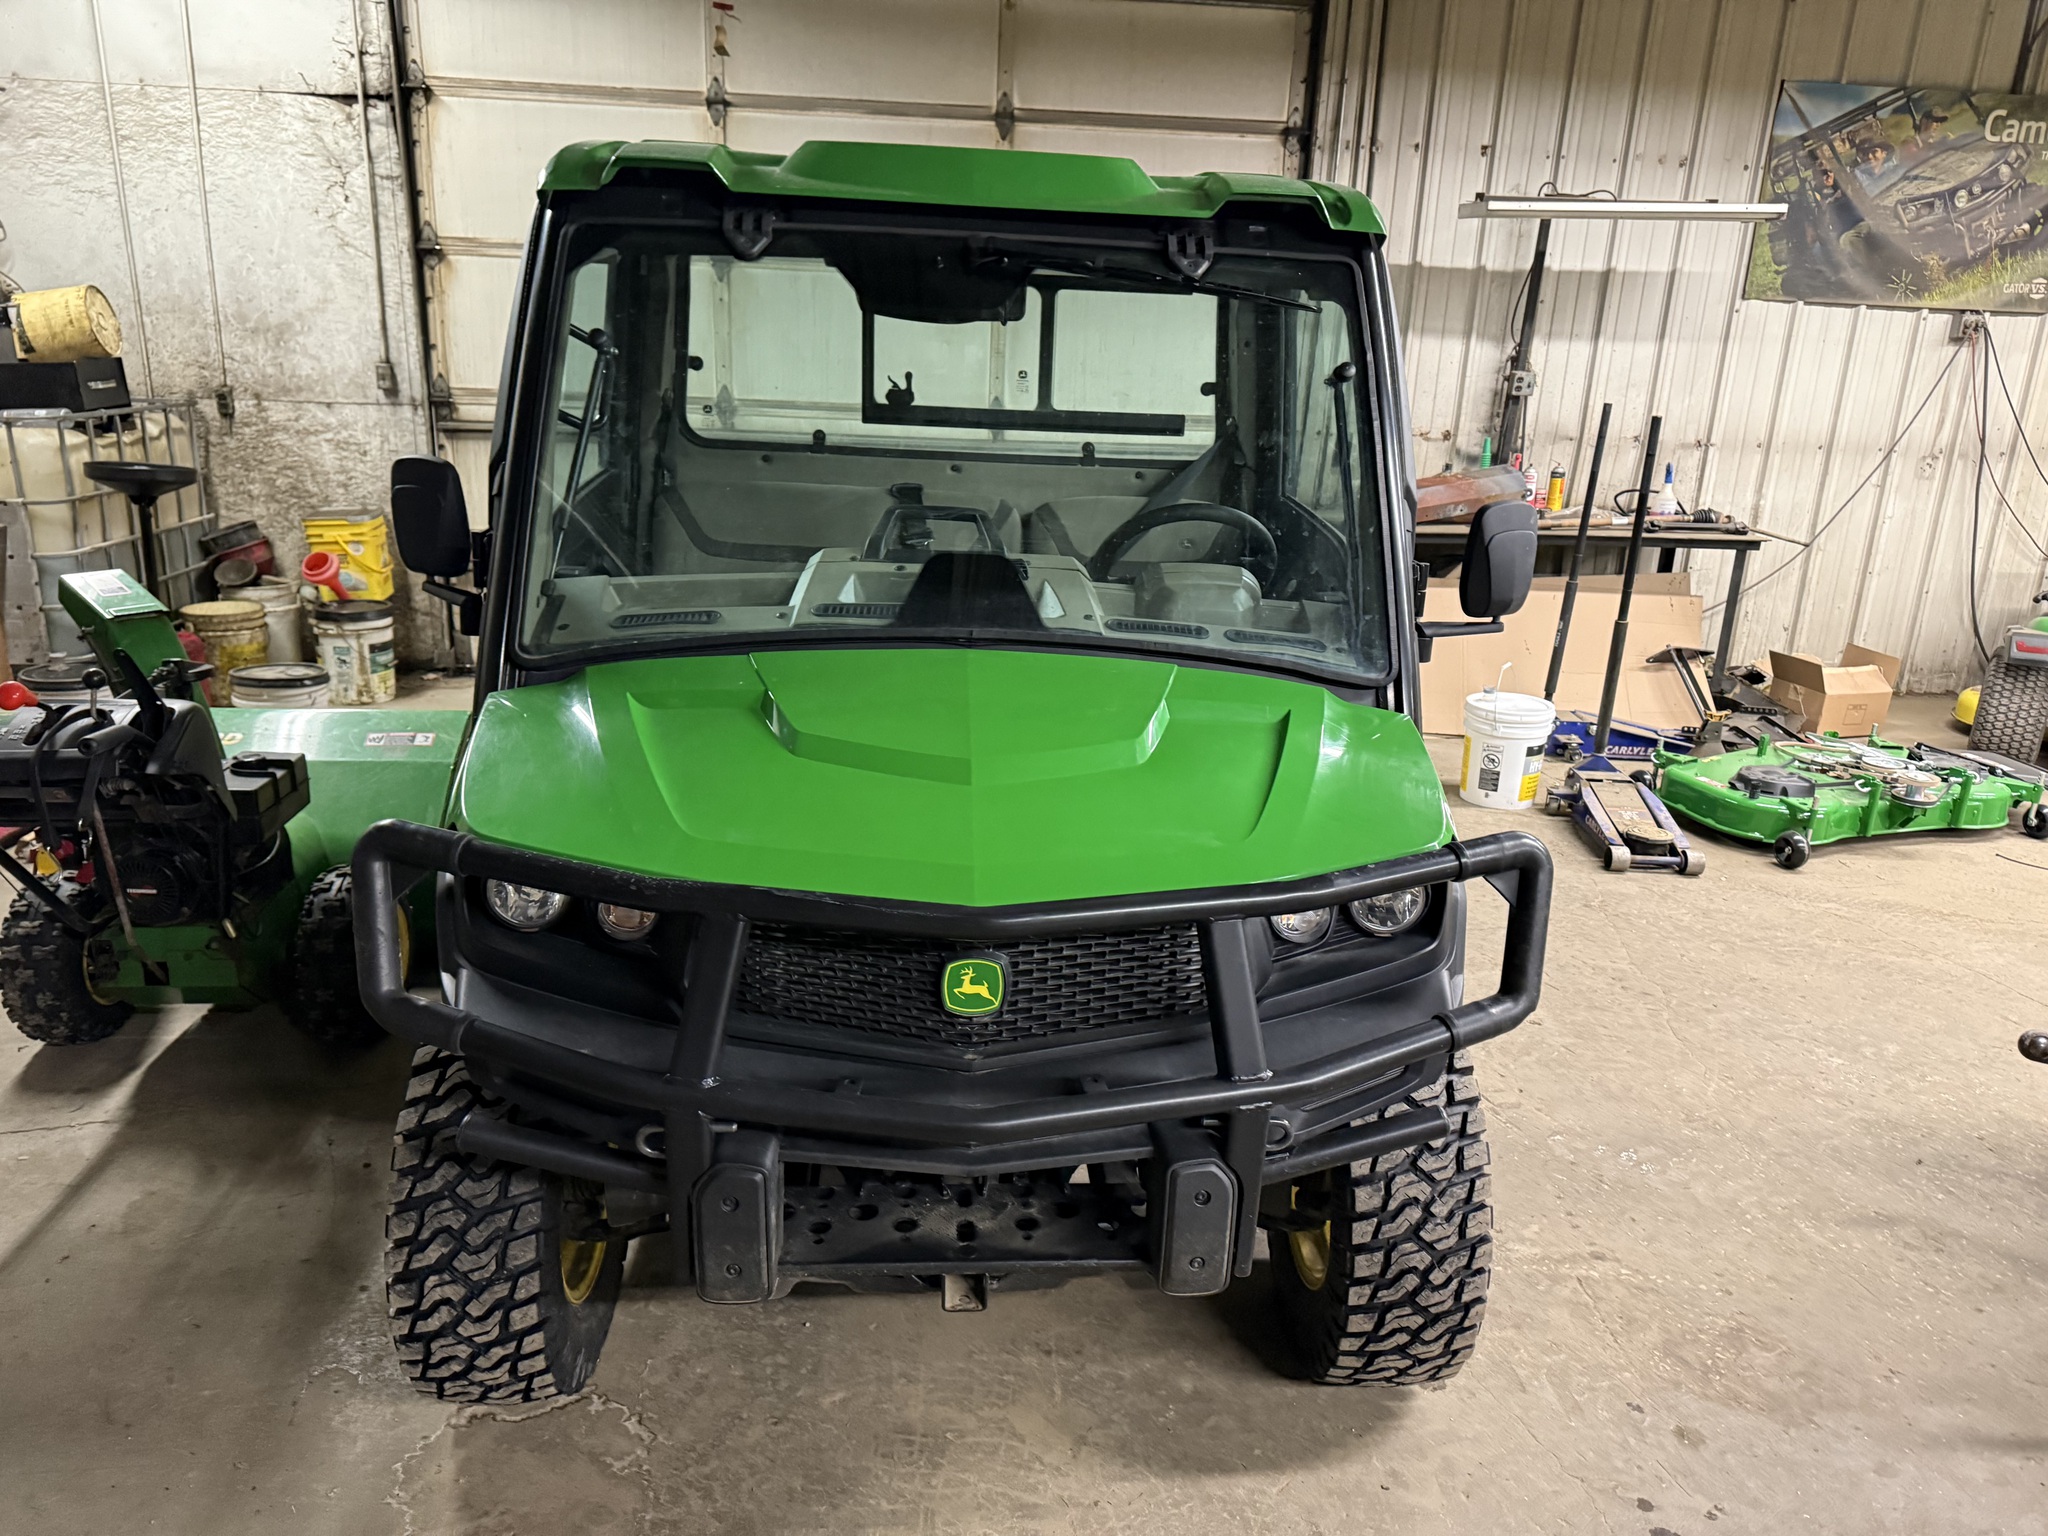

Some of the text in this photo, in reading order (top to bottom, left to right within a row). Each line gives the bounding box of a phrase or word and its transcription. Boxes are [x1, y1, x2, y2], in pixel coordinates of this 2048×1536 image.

[1984, 108, 2048, 144] Cam
[2003, 283, 2047, 294] GATOR VS.
[1604, 745, 1655, 756] CARLYLE
